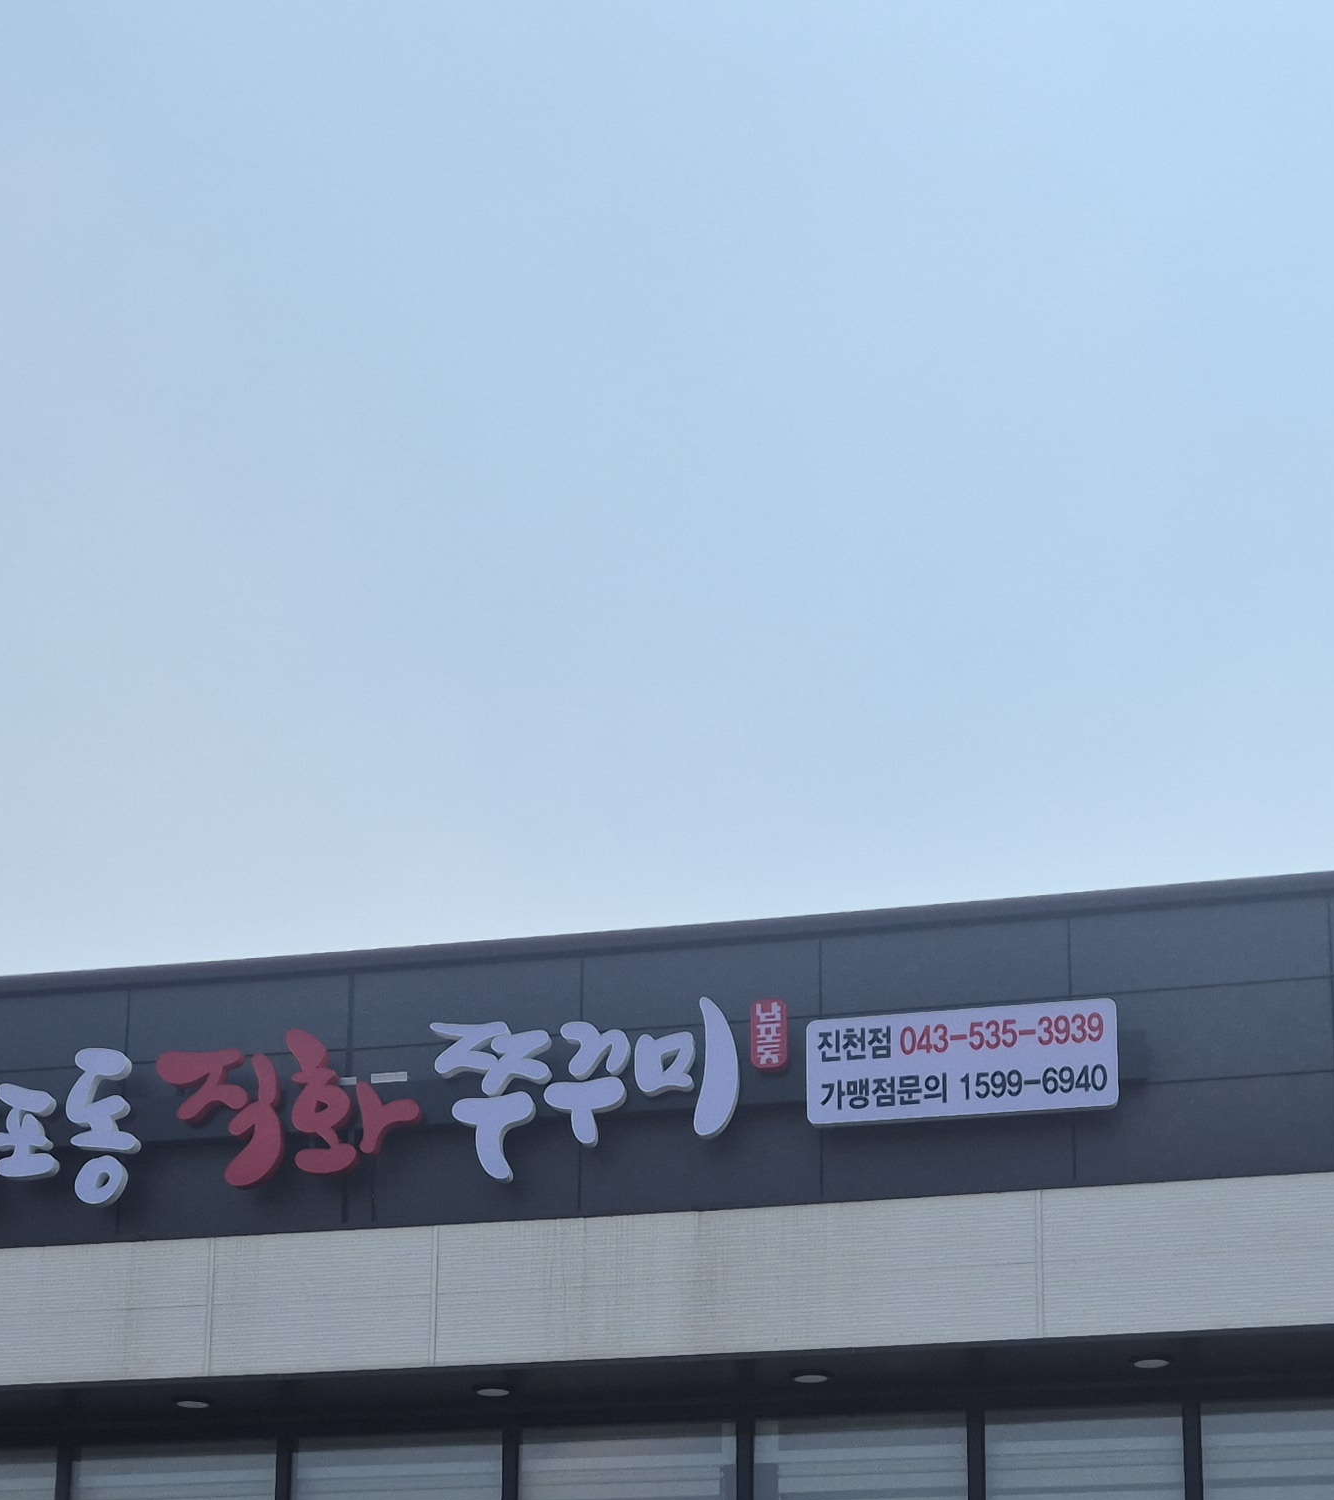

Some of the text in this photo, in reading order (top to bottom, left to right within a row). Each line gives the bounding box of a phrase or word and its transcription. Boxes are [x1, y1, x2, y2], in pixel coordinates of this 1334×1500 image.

[755, 1001, 782, 1065] 남포동
[817, 1012, 1105, 1063] 진천점 043-535-3939
[155, 1027, 424, 1189] 직화
[429, 996, 741, 1184] 쭈꾸미
[819, 1064, 1108, 1111] 가맹점문의 1599-6940
